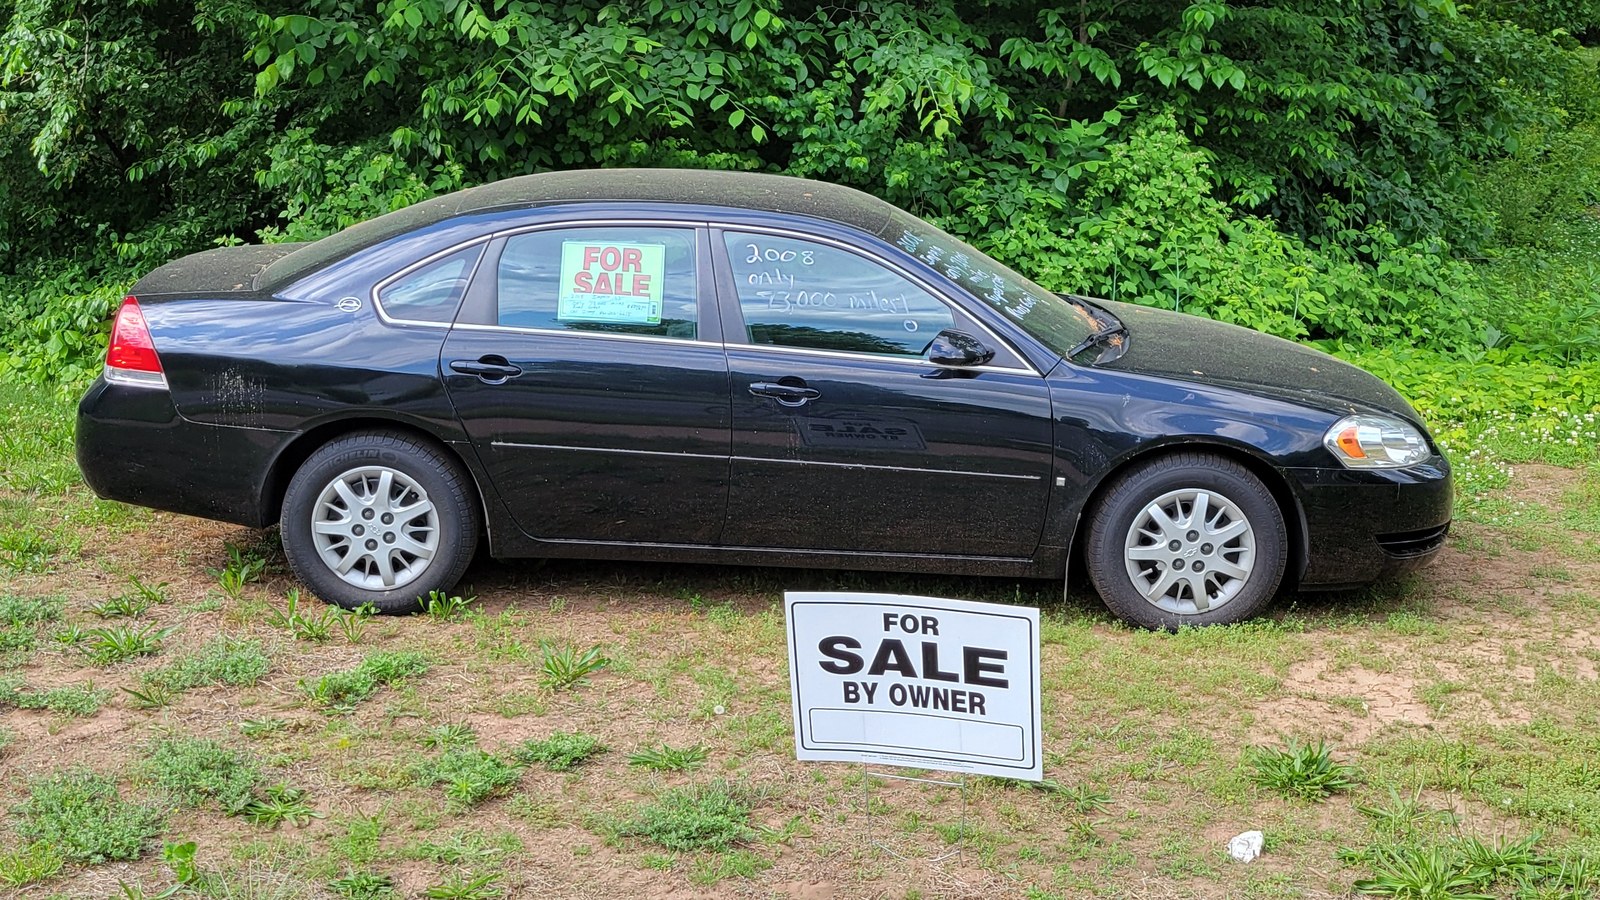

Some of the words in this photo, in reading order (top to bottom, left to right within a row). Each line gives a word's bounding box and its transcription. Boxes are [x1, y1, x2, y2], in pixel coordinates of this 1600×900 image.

[583, 246, 643, 273] FOR
[745, 243, 815, 266] 2008
[573, 271, 651, 297] SALE
[748, 268, 794, 289] only
[321, 449, 380, 470] ICHELIN
[882, 612, 940, 636] FOR
[818, 635, 1010, 689] SALE
[843, 681, 878, 704] BY
[889, 683, 986, 716] OWNER
